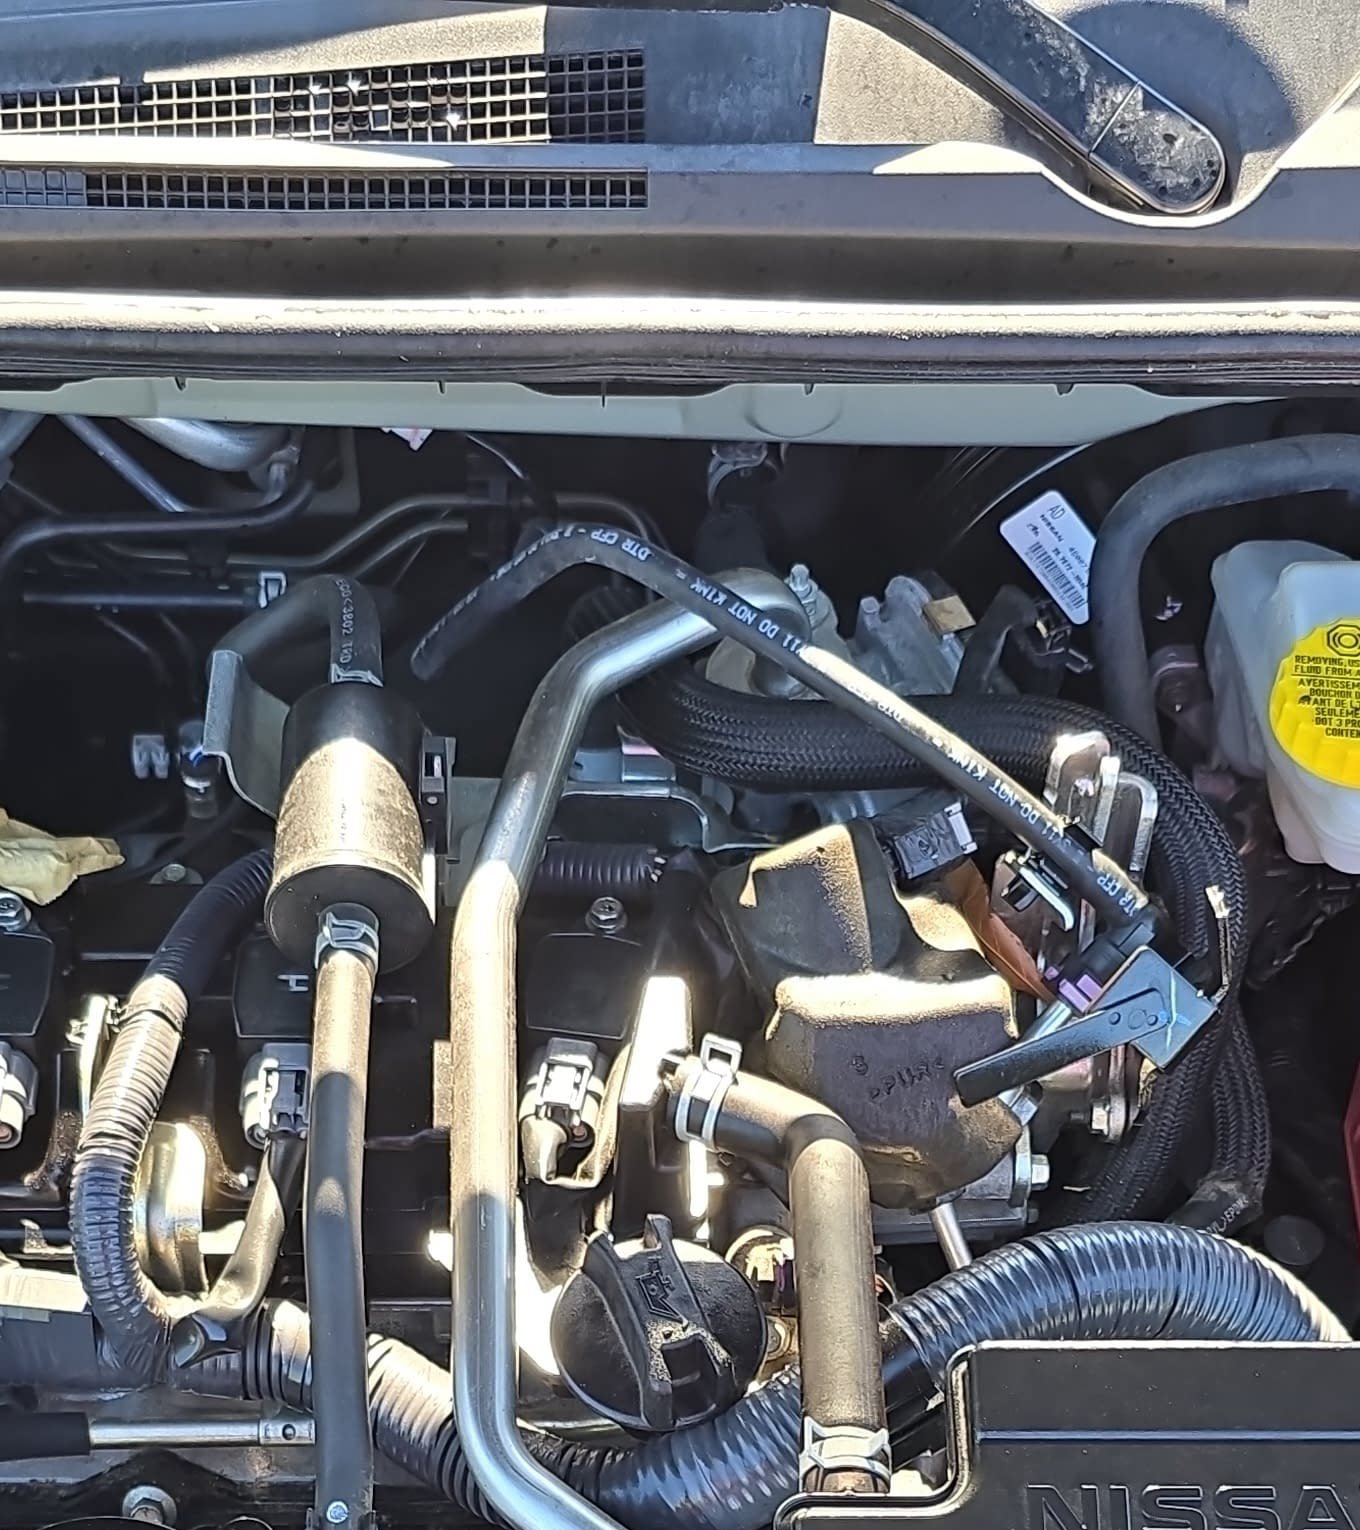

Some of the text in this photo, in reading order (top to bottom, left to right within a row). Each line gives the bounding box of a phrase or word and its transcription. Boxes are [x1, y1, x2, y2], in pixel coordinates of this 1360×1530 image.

[691, 576, 781, 640] DO NOT KINK
[1295, 665, 1321, 675] FLUID
[1325, 667, 1352, 677] FROM
[1309, 688, 1353, 699] BOUCHON
[1335, 698, 1347, 707] DE
[1315, 717, 1333, 726] DOT
[1336, 718, 1342, 727] 3
[989, 778, 1019, 808] NOT
[1019, 806, 1040, 825] DO
